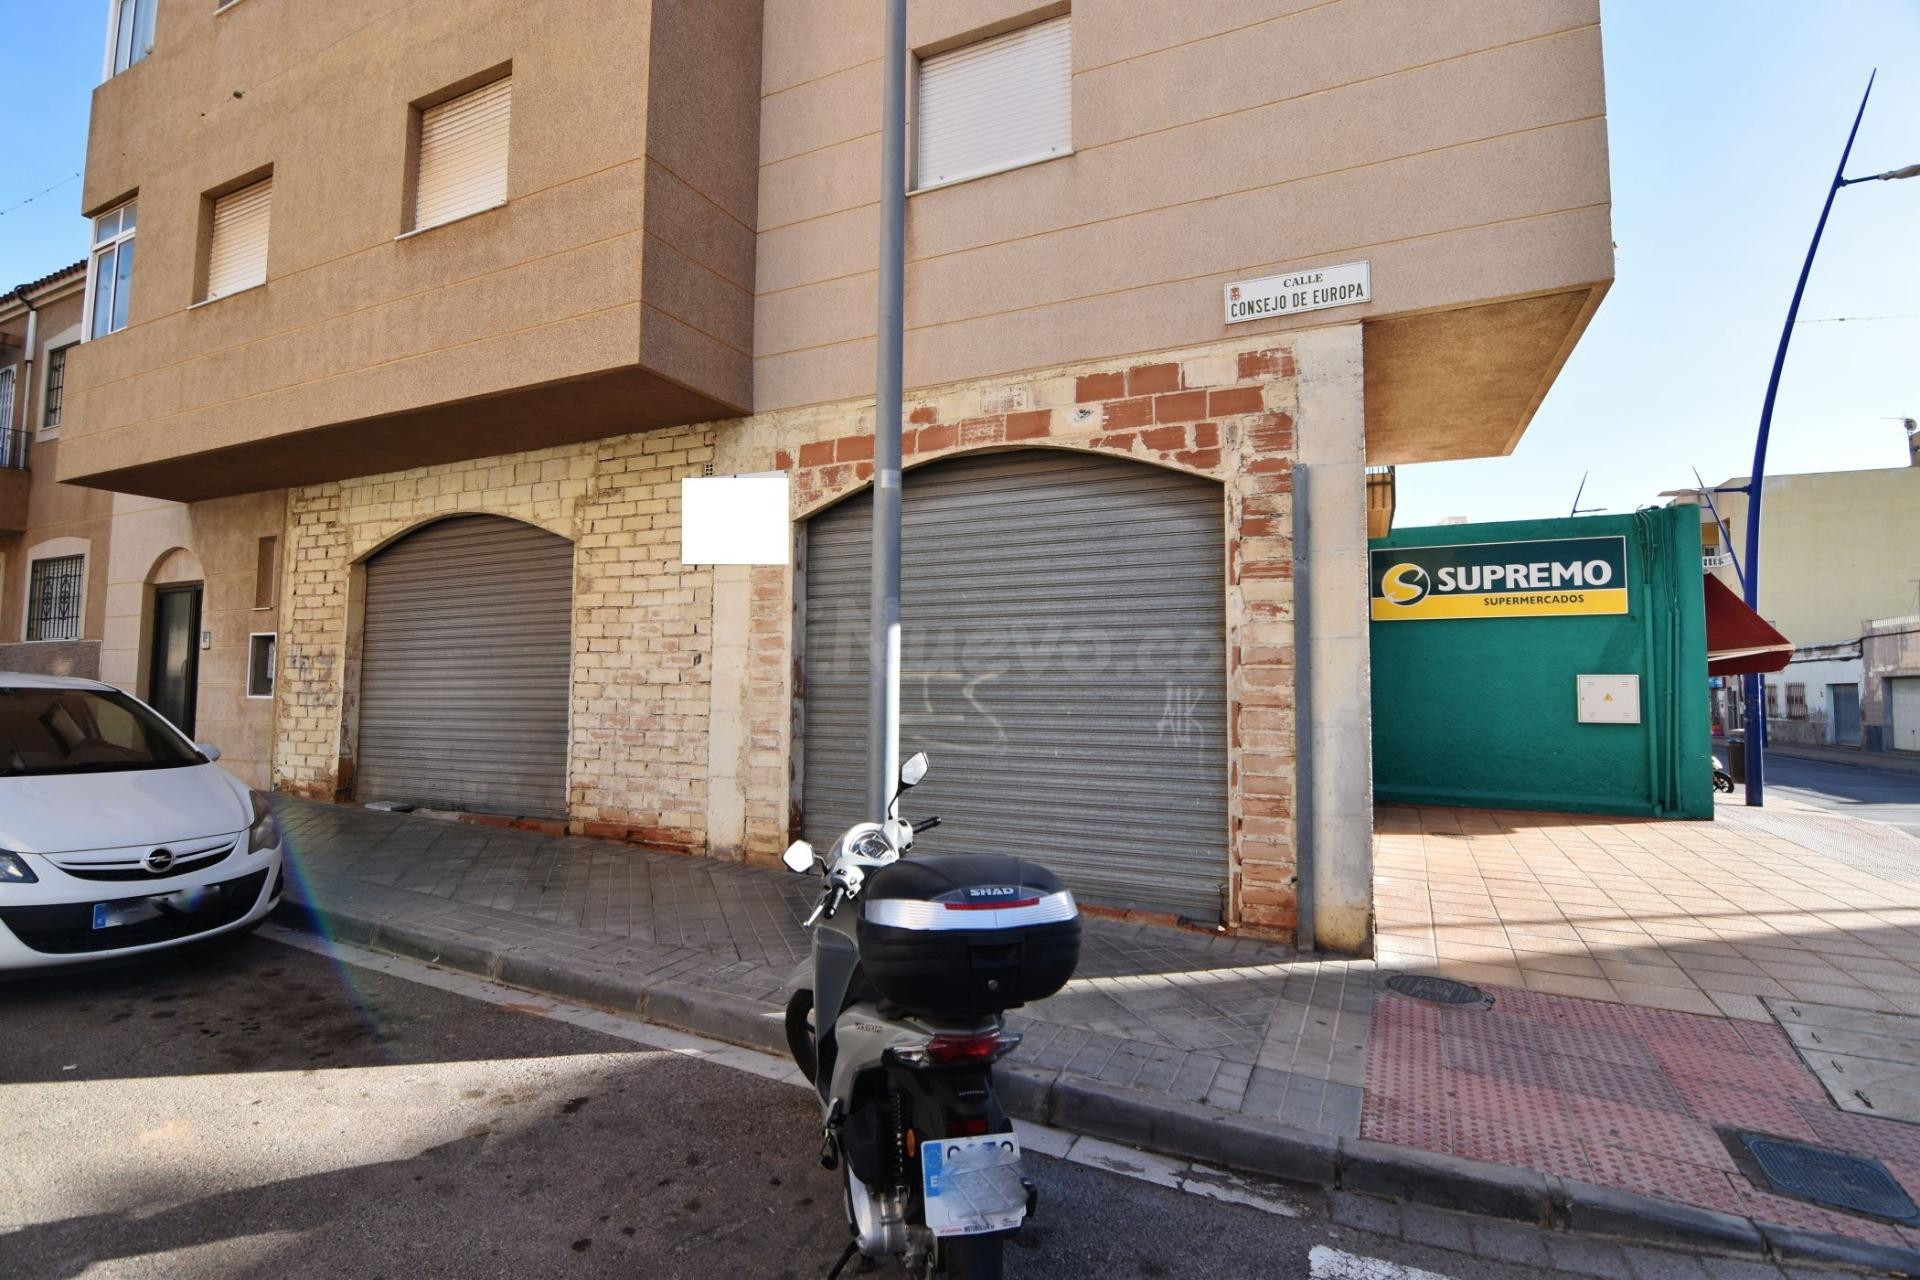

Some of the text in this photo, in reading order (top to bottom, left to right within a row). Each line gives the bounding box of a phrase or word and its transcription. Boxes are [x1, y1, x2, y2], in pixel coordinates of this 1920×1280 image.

[1283, 273, 1324, 288] CALLE
[1231, 282, 1364, 318] CONSEJO DE EUROPA
[1437, 560, 1613, 592] SUPREMO
[1483, 594, 1585, 606] SUPERMERCADOS
[970, 887, 1015, 897] SHAD
